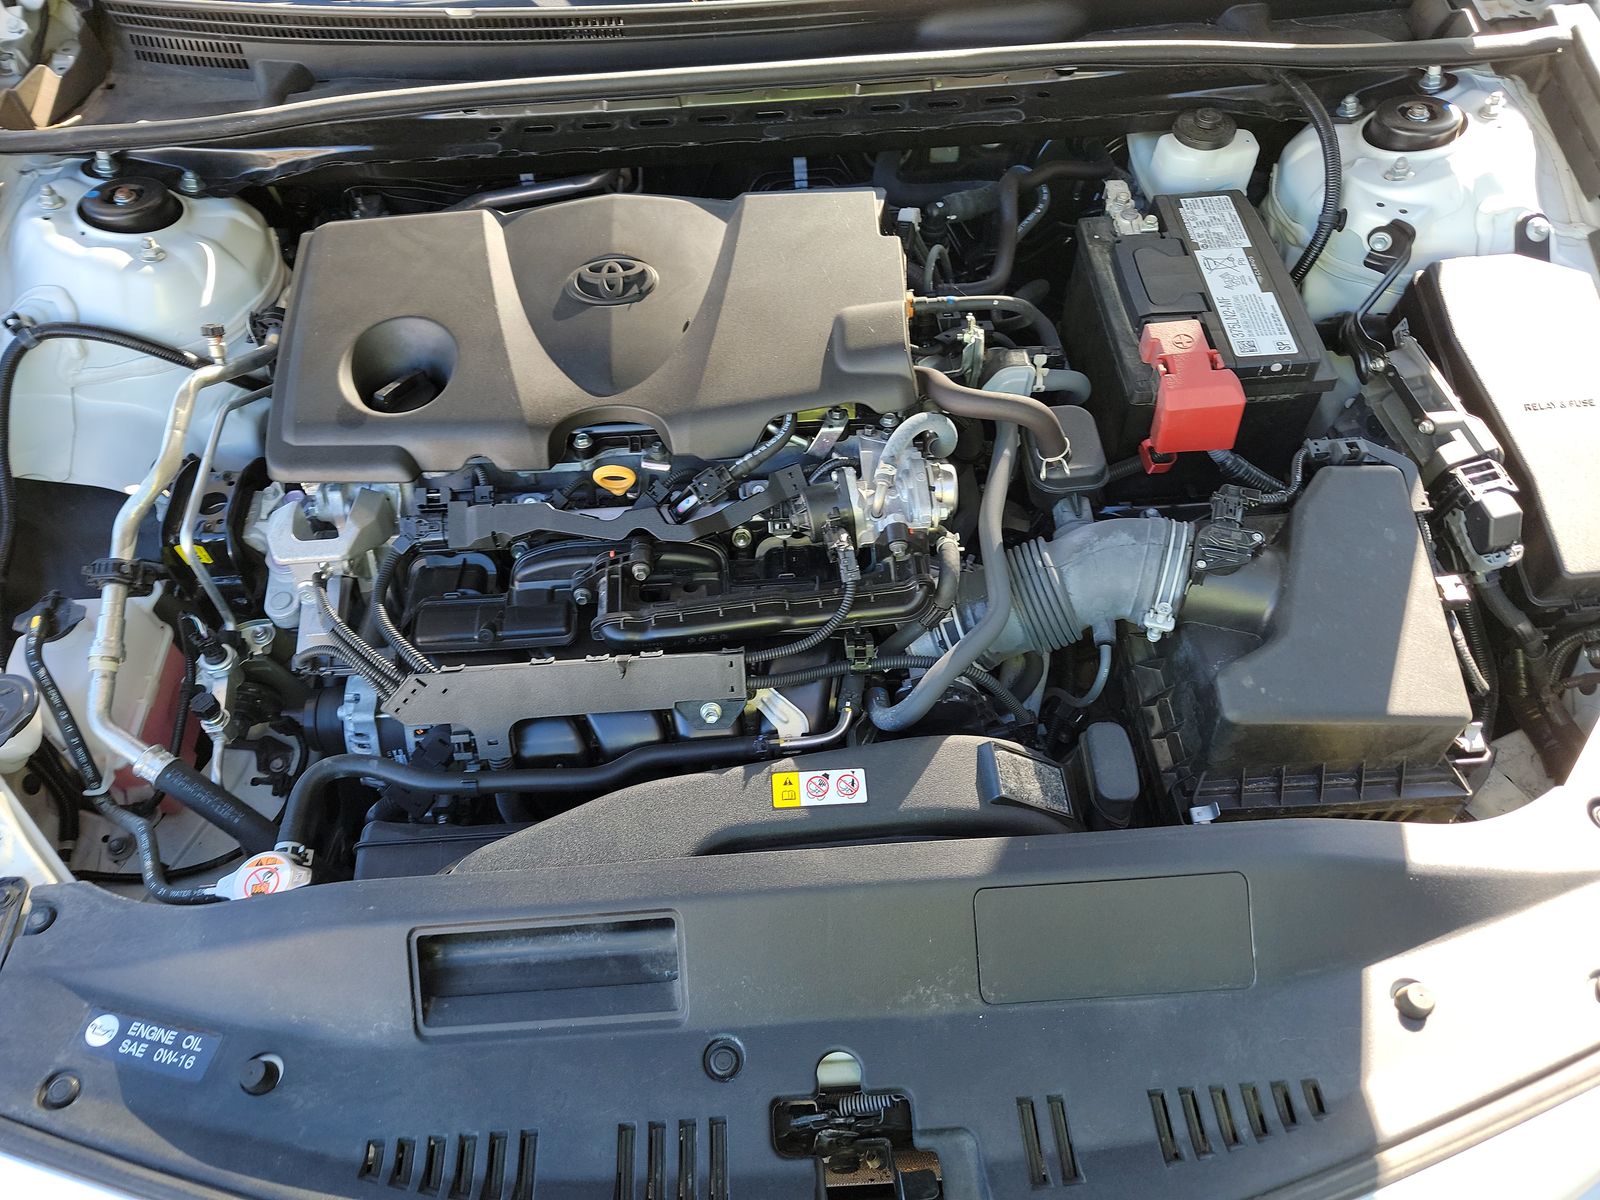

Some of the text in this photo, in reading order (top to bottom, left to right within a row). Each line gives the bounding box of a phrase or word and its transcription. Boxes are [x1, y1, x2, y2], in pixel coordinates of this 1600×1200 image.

[1218, 296, 1245, 338] 375LN2-MF
[1277, 340, 1292, 352] SP
[1524, 402, 1556, 412] RELAY
[1568, 398, 1596, 408] FUSE
[127, 1022, 203, 1052] ENGINE OIL
[118, 1039, 196, 1070] SAE 0W-16
